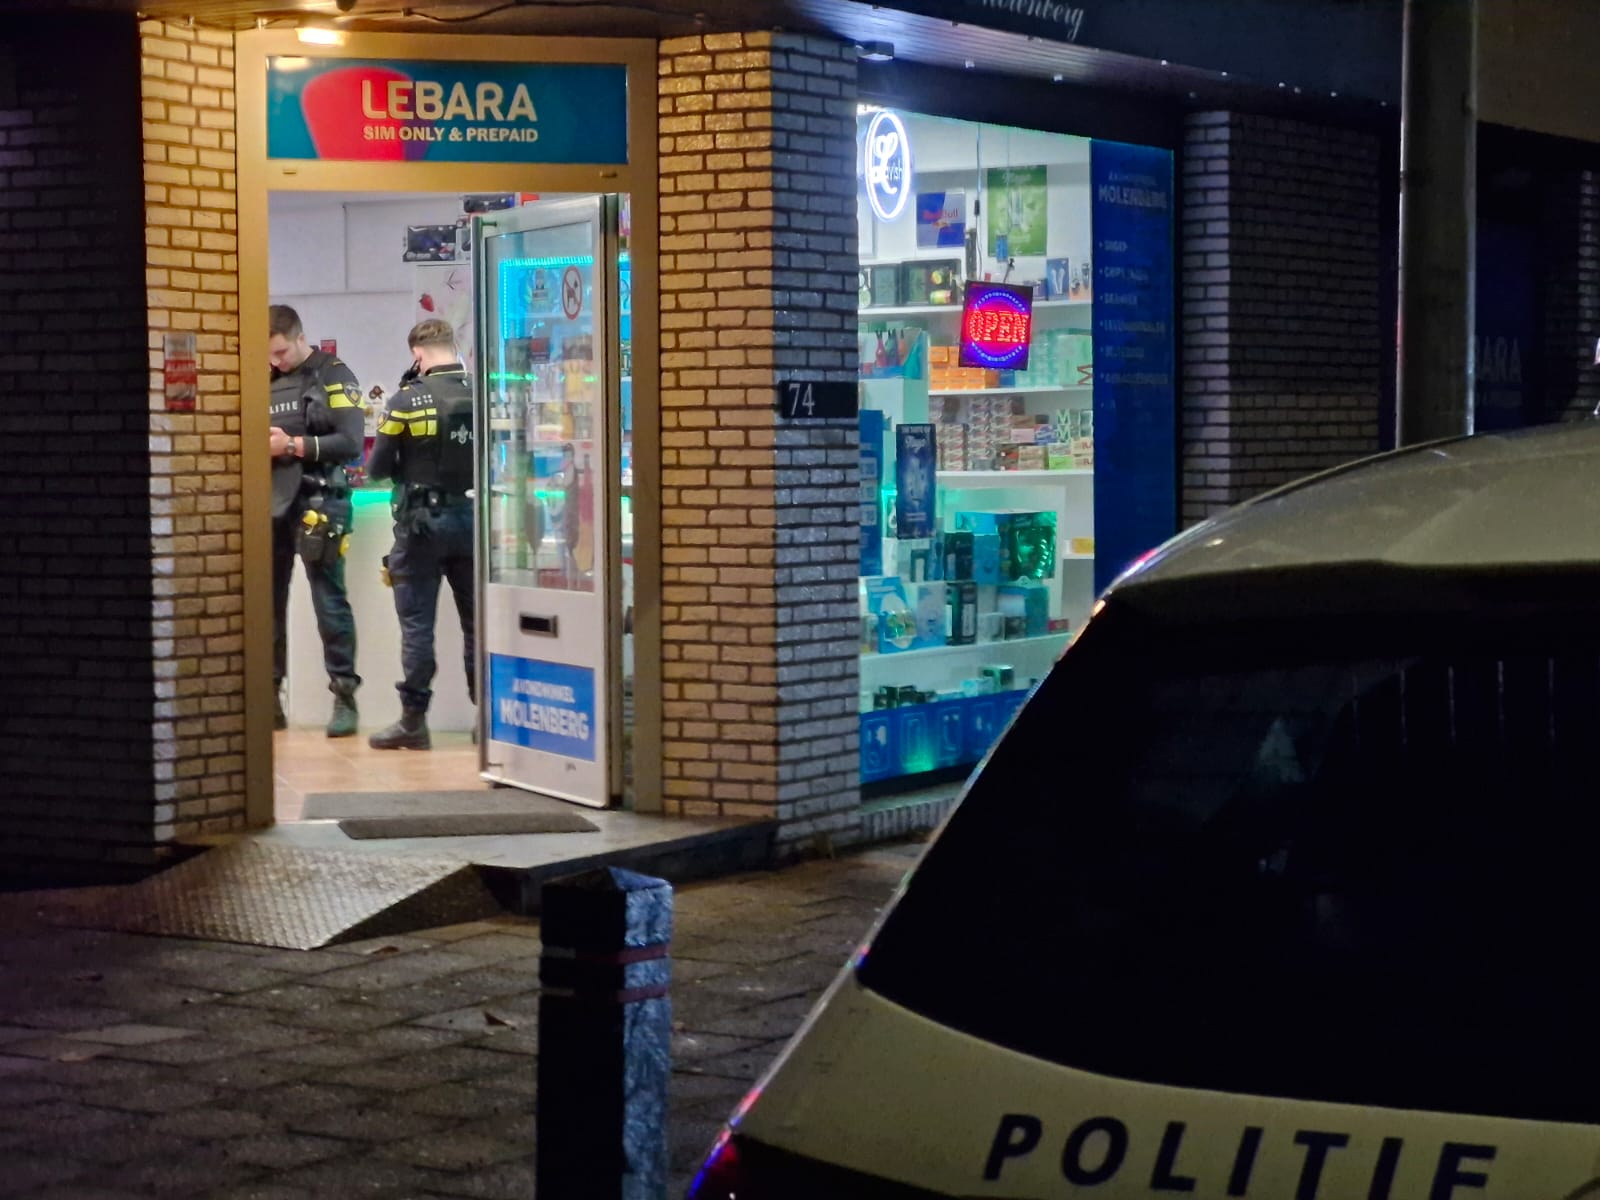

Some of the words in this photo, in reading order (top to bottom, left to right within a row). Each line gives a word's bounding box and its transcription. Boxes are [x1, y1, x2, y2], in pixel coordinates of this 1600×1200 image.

[360, 79, 538, 122] LEBARA
[363, 126, 395, 141] SIM
[399, 126, 446, 142] ONLY
[449, 127, 464, 142] &
[466, 127, 539, 143] PREPAID
[969, 309, 1029, 344] OPEN
[788, 382, 816, 417] 74
[500, 698, 590, 741] MOLENBERG
